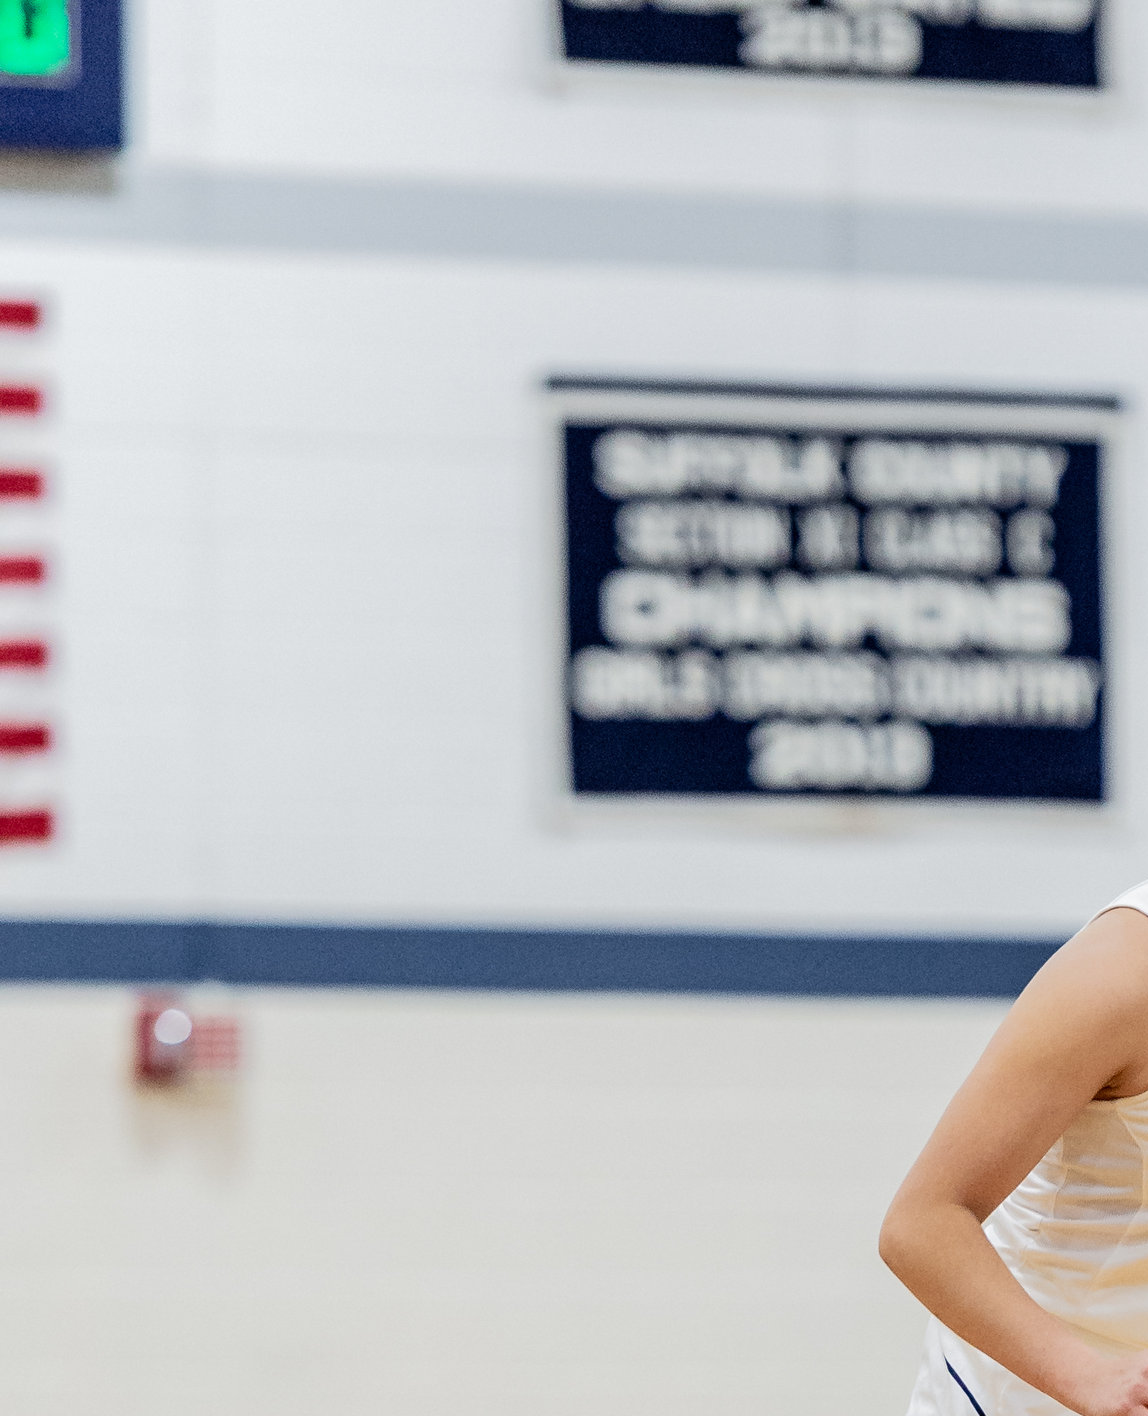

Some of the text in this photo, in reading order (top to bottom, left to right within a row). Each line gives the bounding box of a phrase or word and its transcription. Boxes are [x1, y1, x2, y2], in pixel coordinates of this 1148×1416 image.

[595, 431, 1069, 510] SUFFOLK COUNTY
[601, 569, 1071, 653] CHAMPIONS
